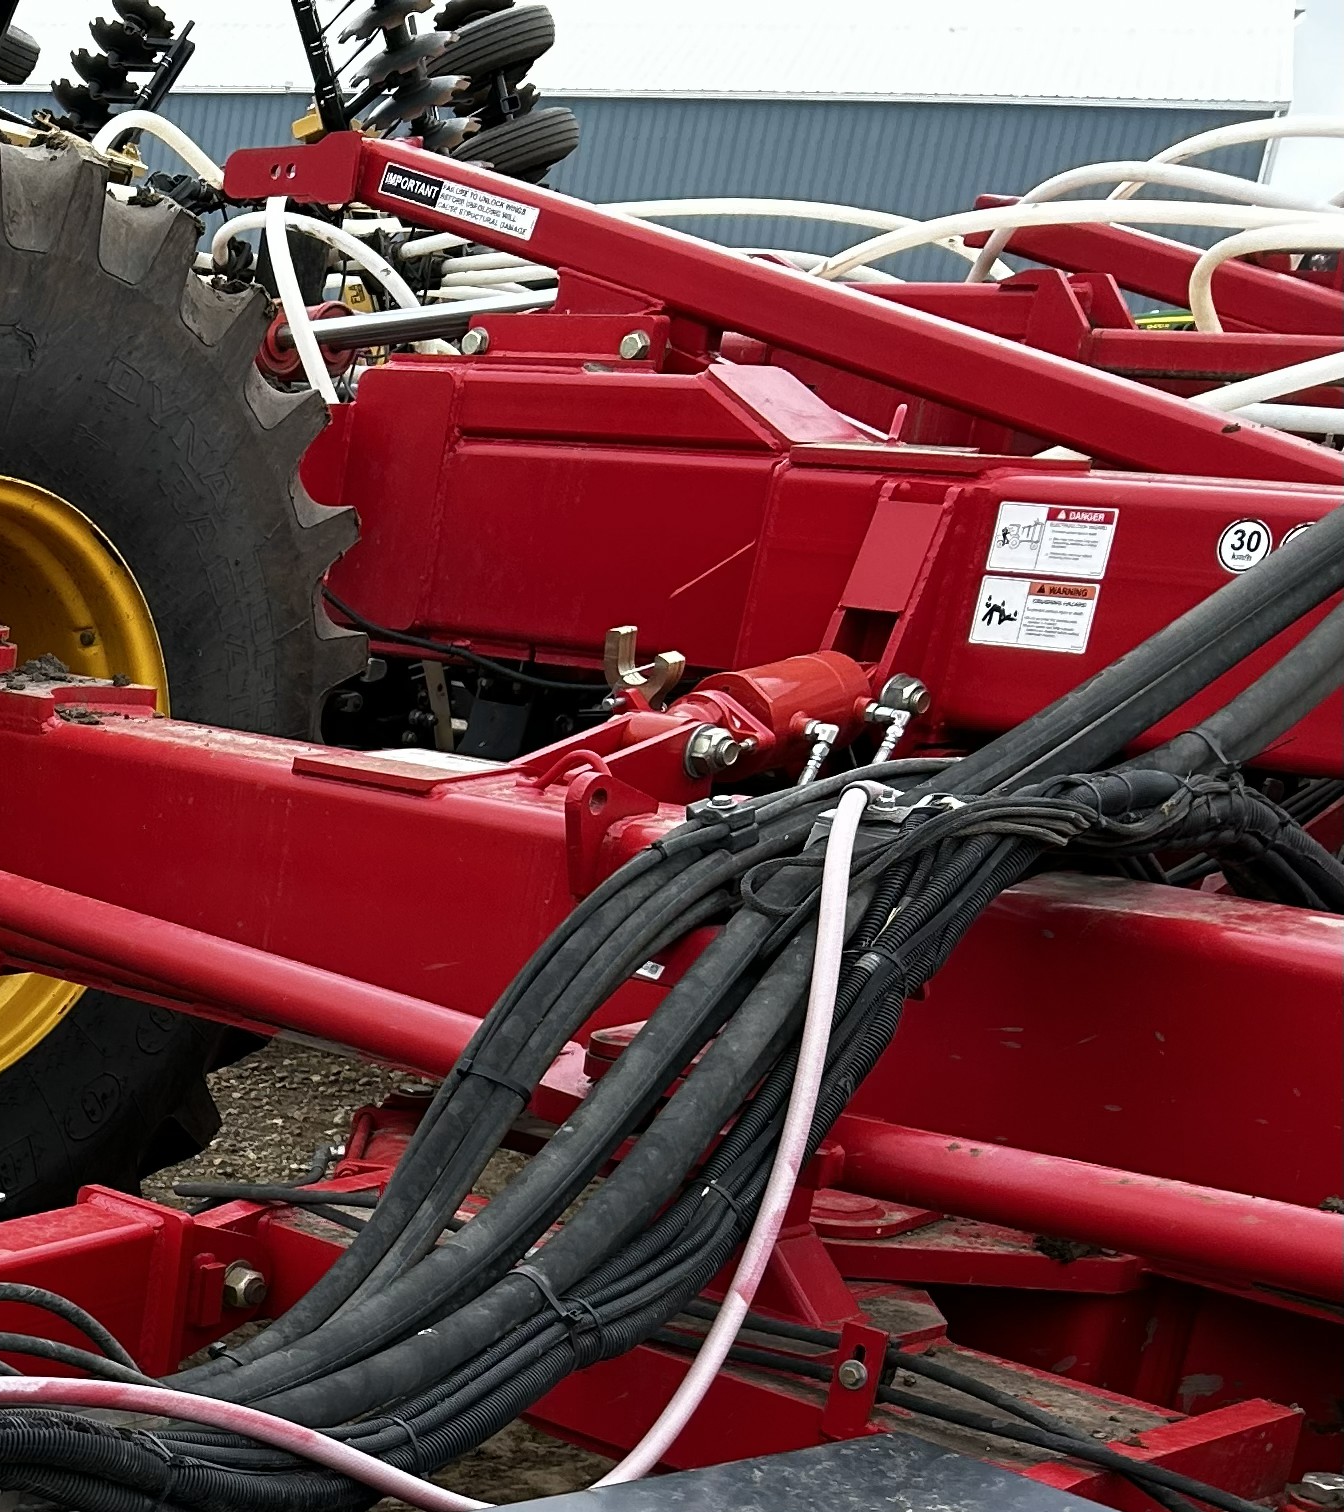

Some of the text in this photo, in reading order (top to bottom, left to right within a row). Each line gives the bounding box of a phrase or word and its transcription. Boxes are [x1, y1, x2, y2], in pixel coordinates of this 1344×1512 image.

[384, 171, 440, 200] IMPORTANT
[1069, 511, 1105, 521] DANGER
[1230, 528, 1262, 553] 30
[1049, 586, 1088, 597] WARNING
